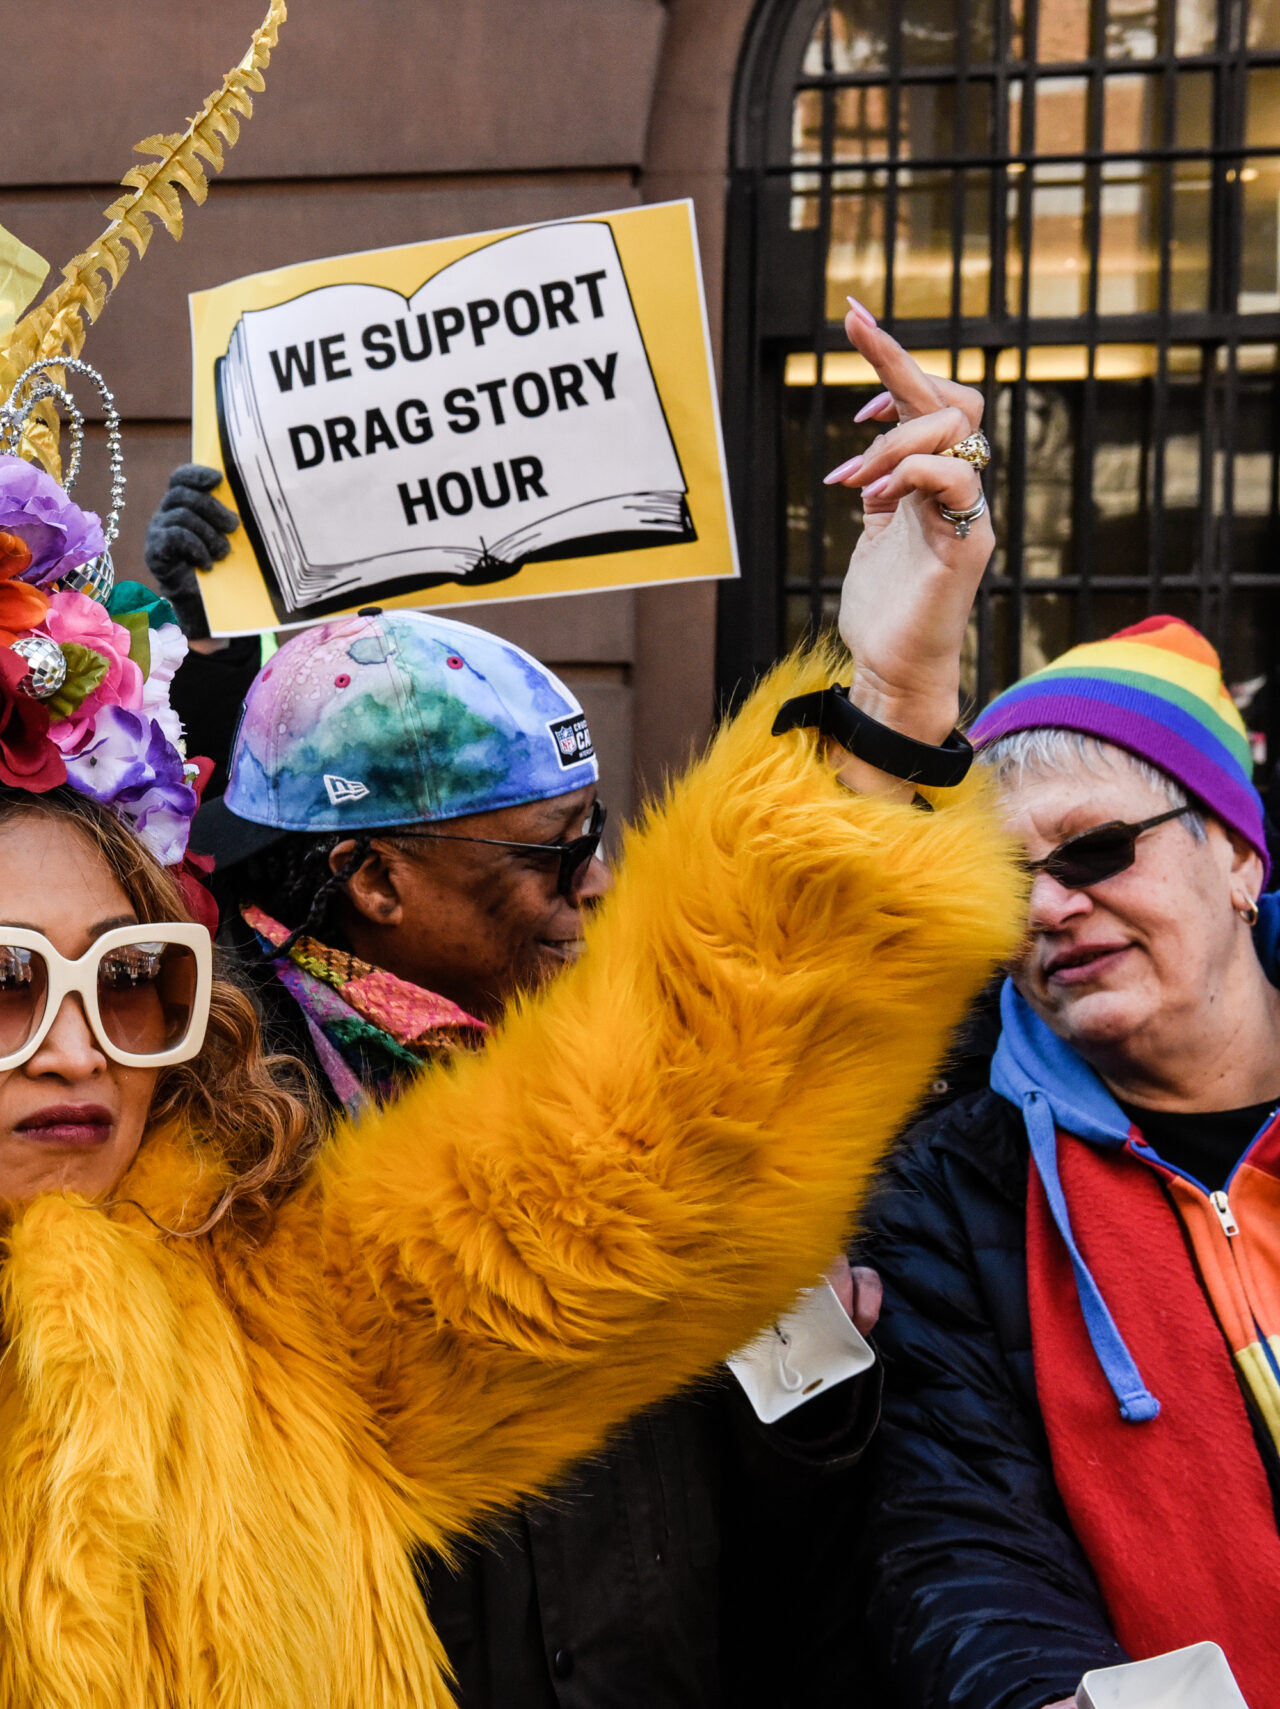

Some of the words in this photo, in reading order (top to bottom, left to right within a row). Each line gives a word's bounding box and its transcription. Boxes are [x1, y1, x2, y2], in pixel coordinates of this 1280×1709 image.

[269, 333, 353, 393] WE
[362, 270, 607, 371] SUPPORT
[287, 399, 432, 471] DRAG
[444, 352, 619, 436] STORY
[397, 455, 549, 526] HOUR
